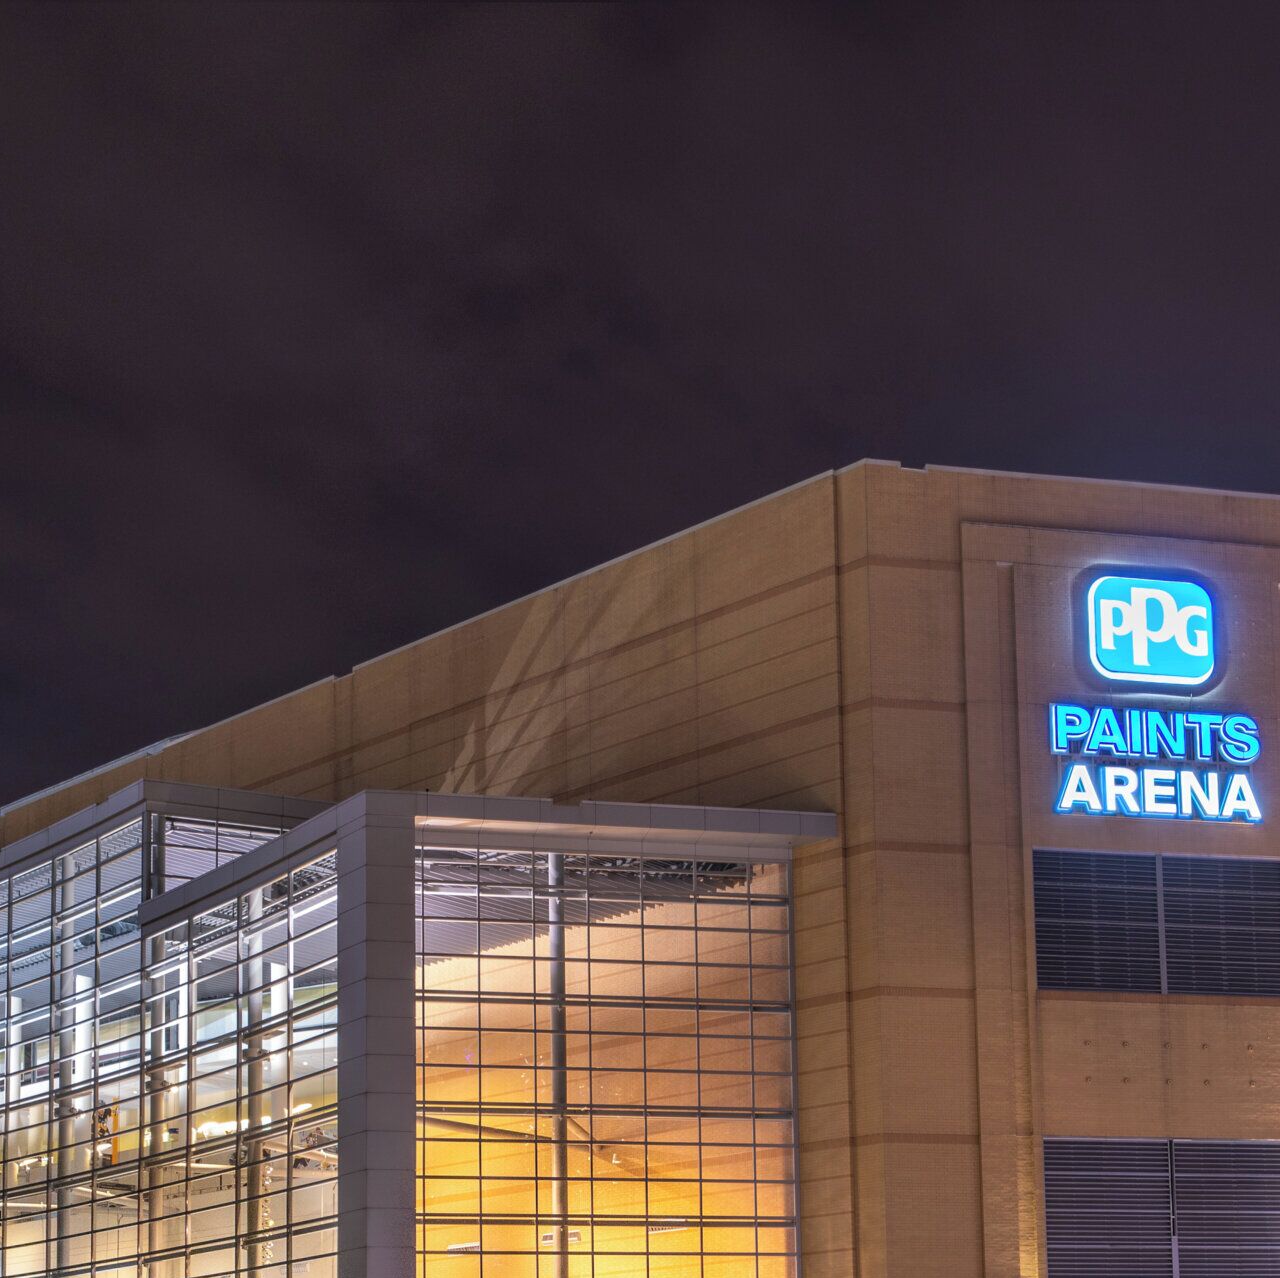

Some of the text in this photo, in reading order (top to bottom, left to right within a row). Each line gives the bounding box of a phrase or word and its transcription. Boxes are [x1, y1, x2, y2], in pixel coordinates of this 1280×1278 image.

[1099, 586, 1210, 667] PPG
[1053, 704, 1261, 763] PAINTS
[1056, 764, 1263, 823] ARENA
